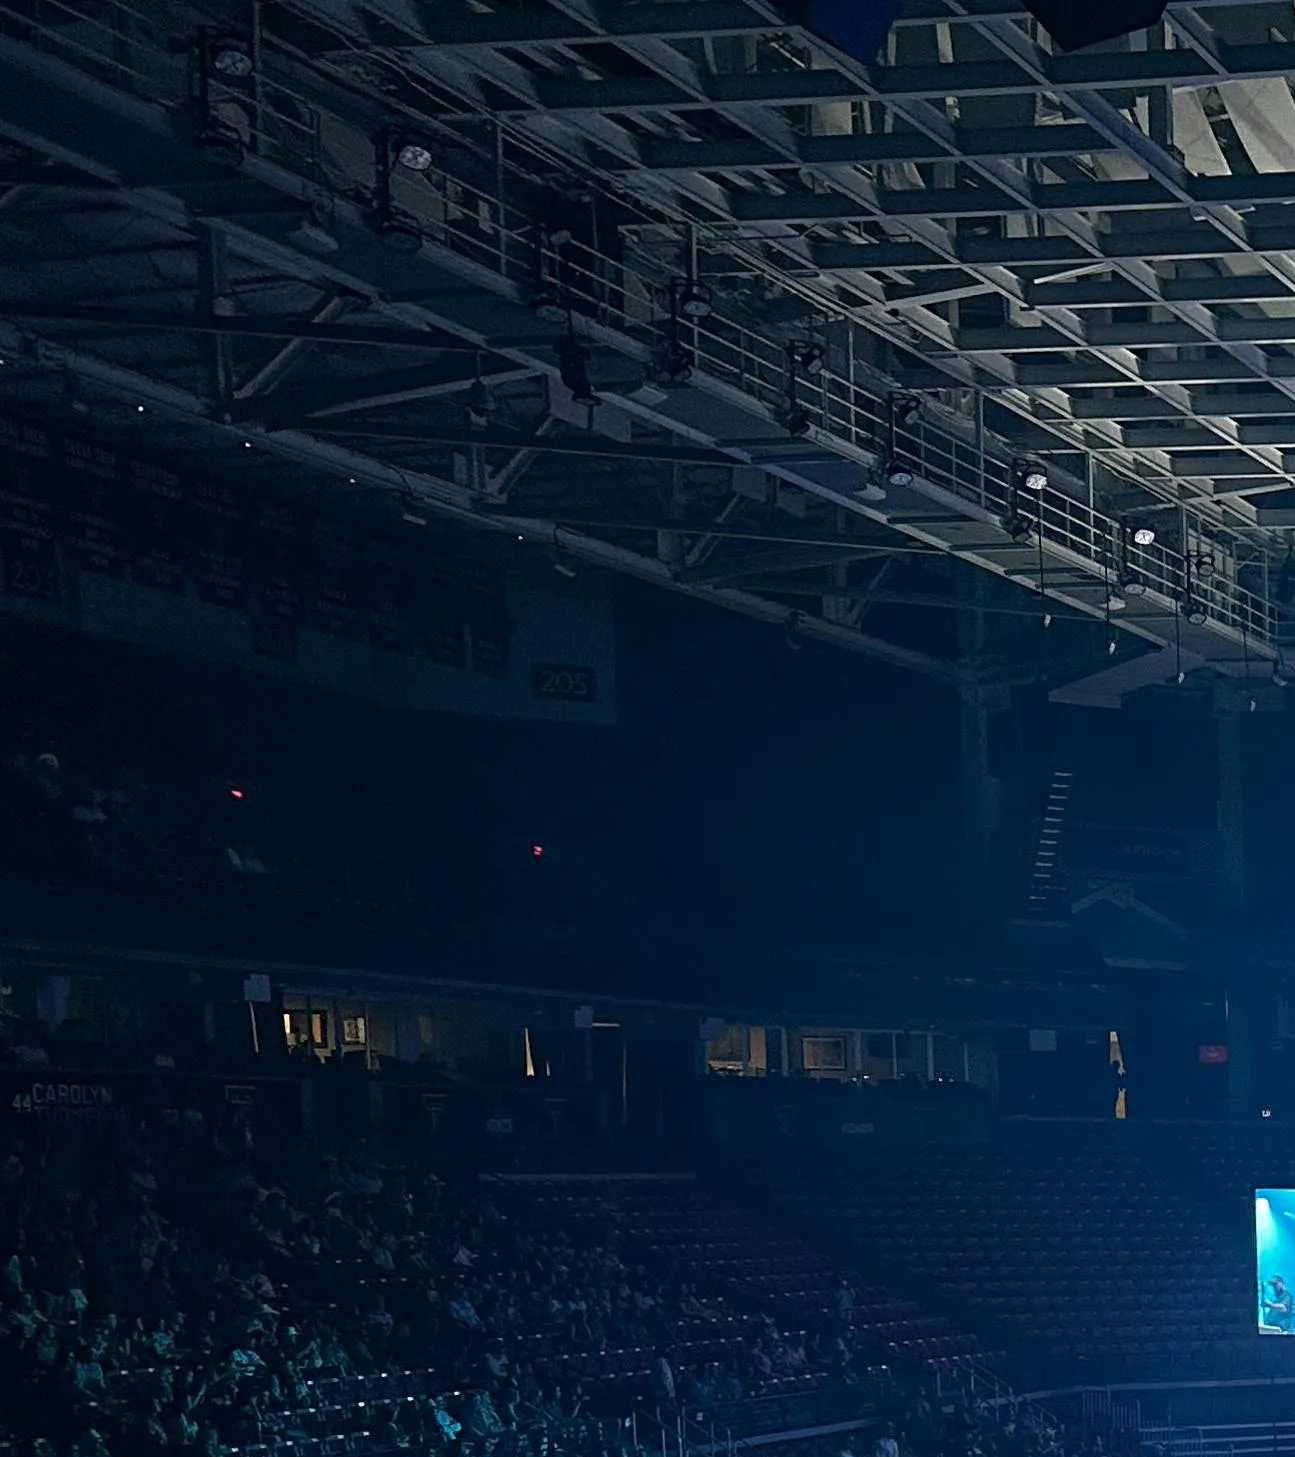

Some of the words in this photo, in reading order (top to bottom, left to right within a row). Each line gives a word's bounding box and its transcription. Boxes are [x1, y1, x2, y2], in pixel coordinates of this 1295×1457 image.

[541, 669, 589, 696] 205
[12, 1094, 31, 1114] 44
[32, 1083, 113, 1105] CAROLYN
